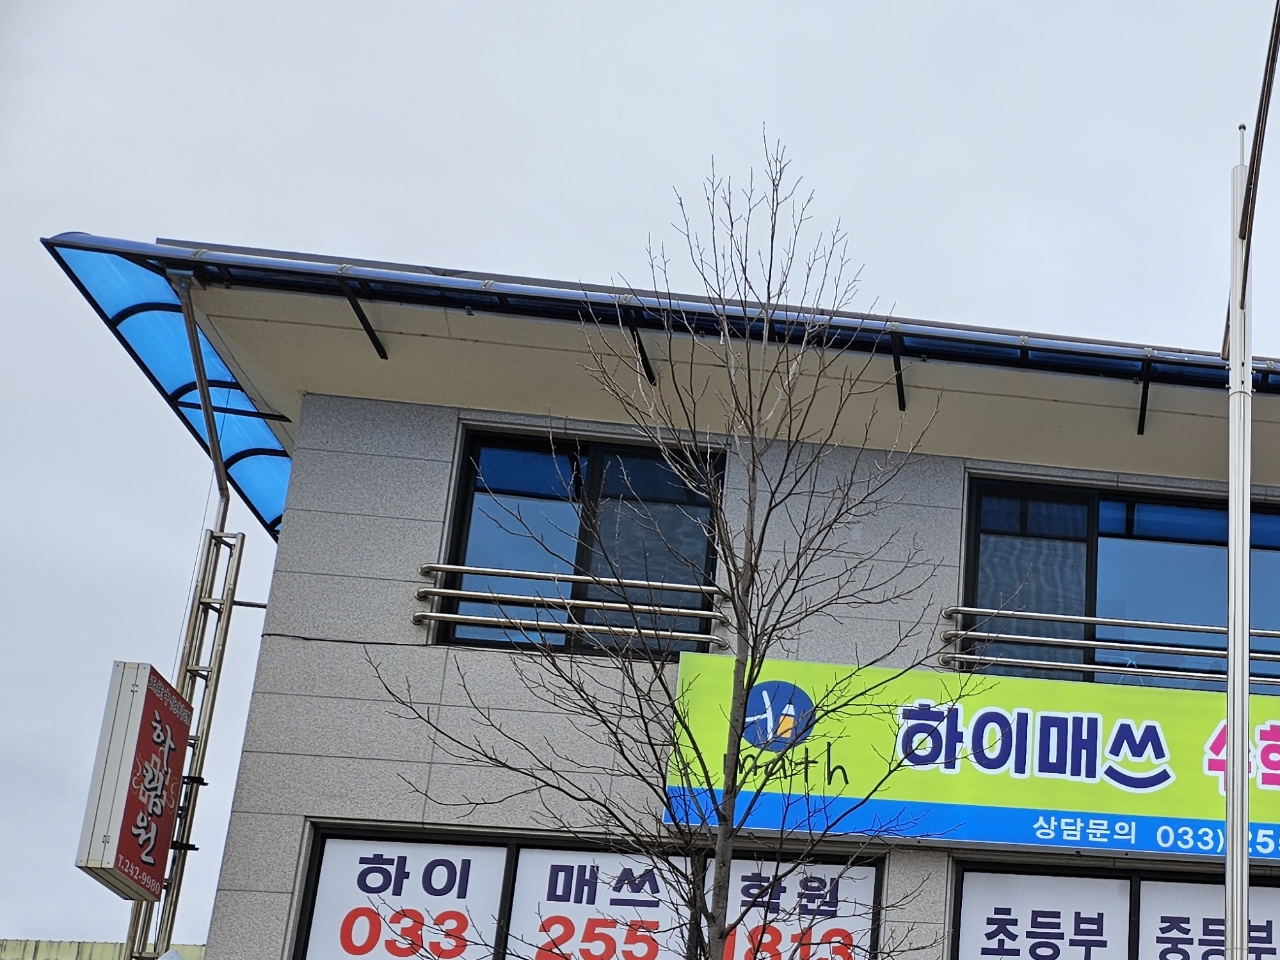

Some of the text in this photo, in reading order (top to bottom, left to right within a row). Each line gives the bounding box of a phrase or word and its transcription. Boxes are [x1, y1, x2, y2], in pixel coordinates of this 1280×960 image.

[901, 702, 1171, 789] 하이매쓰
[1033, 816, 1137, 845] 상담문의
[118, 854, 160, 895] T.242-9980
[356, 854, 472, 899] 하이
[547, 865, 660, 908] 매쓰
[740, 872, 840, 917] 학원
[340, 907, 469, 959] 033
